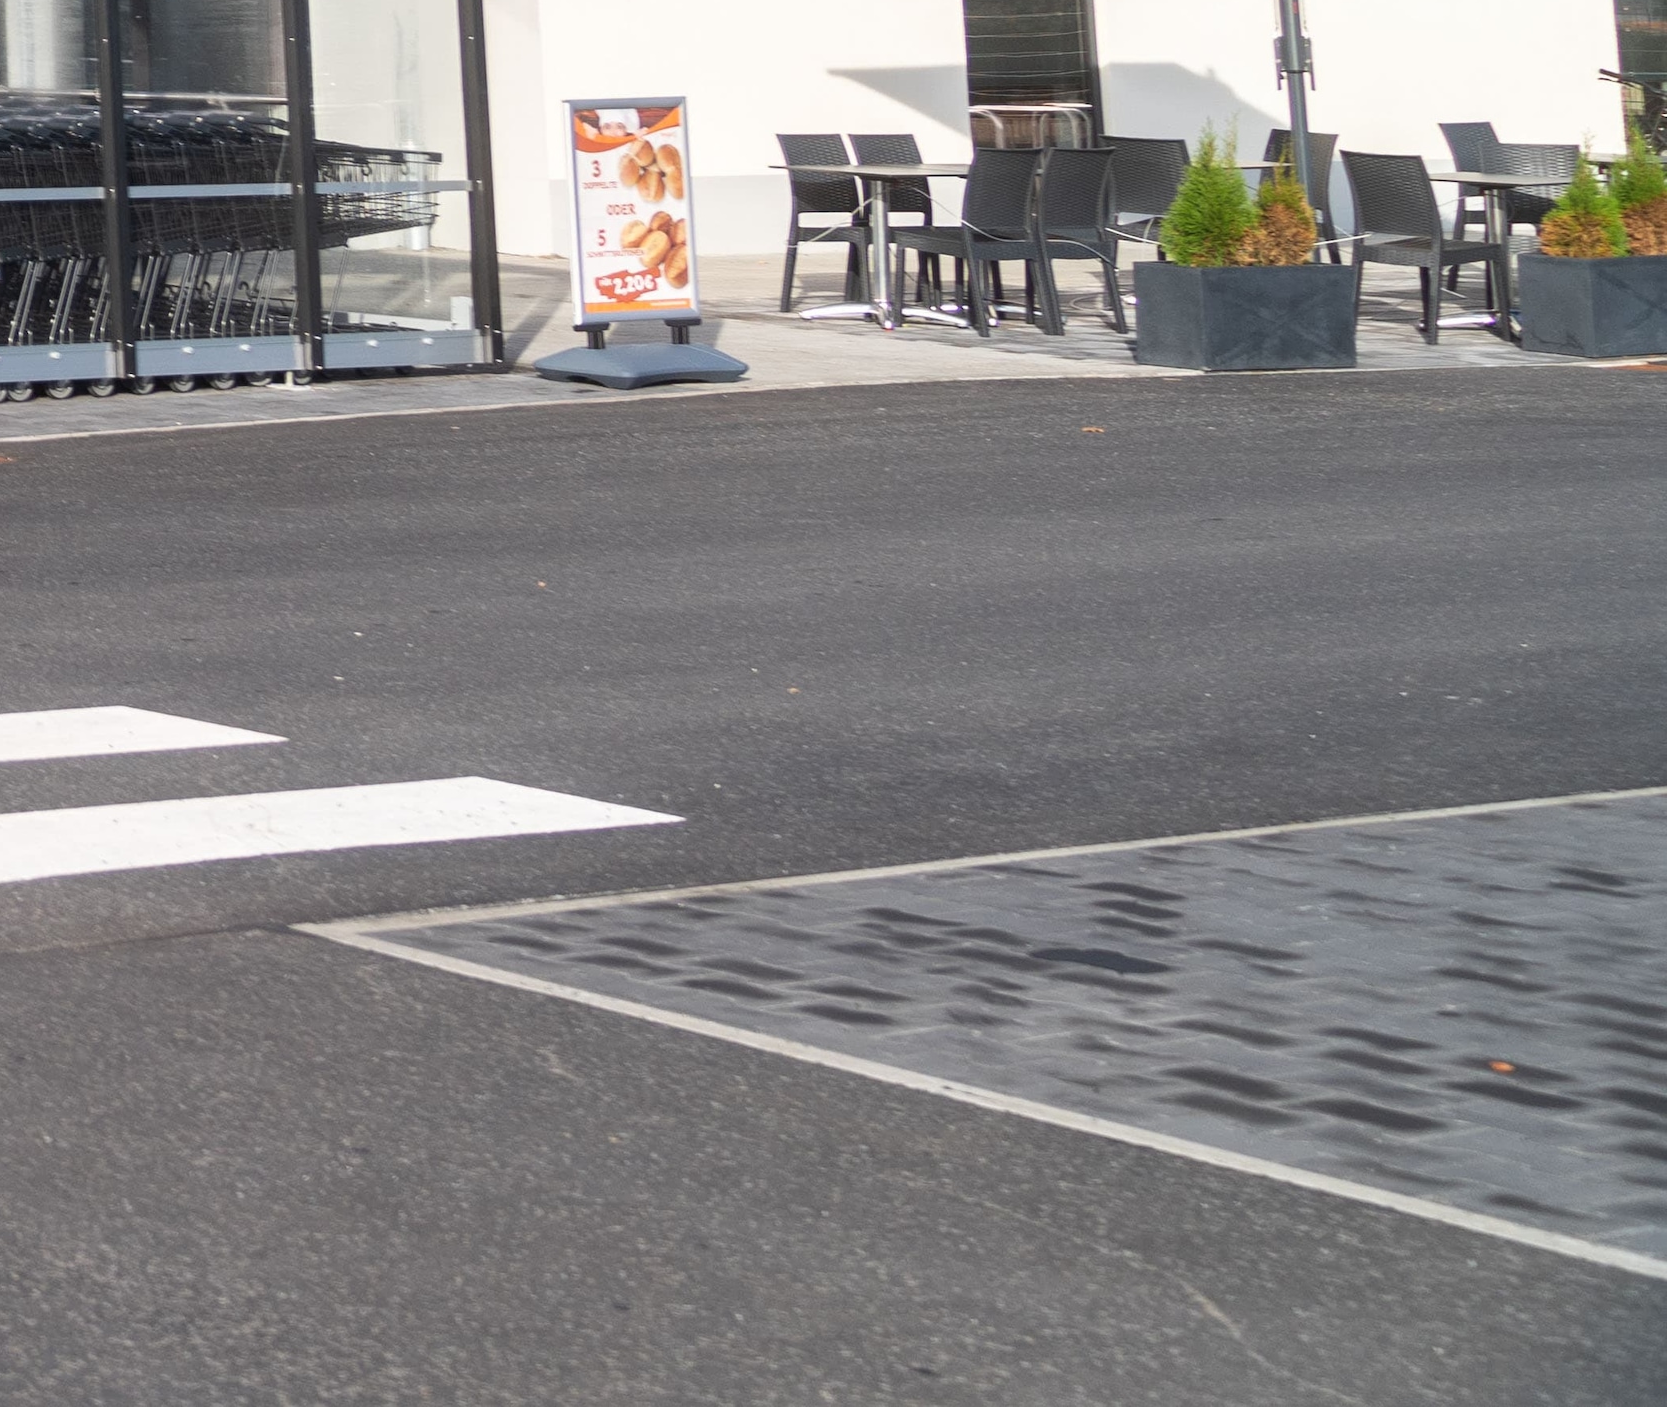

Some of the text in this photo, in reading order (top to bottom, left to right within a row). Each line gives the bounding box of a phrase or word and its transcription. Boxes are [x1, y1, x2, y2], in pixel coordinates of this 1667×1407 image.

[591, 160, 601, 178] 3
[606, 203, 636, 216] ODER
[597, 229, 606, 246] 5
[613, 274, 654, 296] 2,20€
